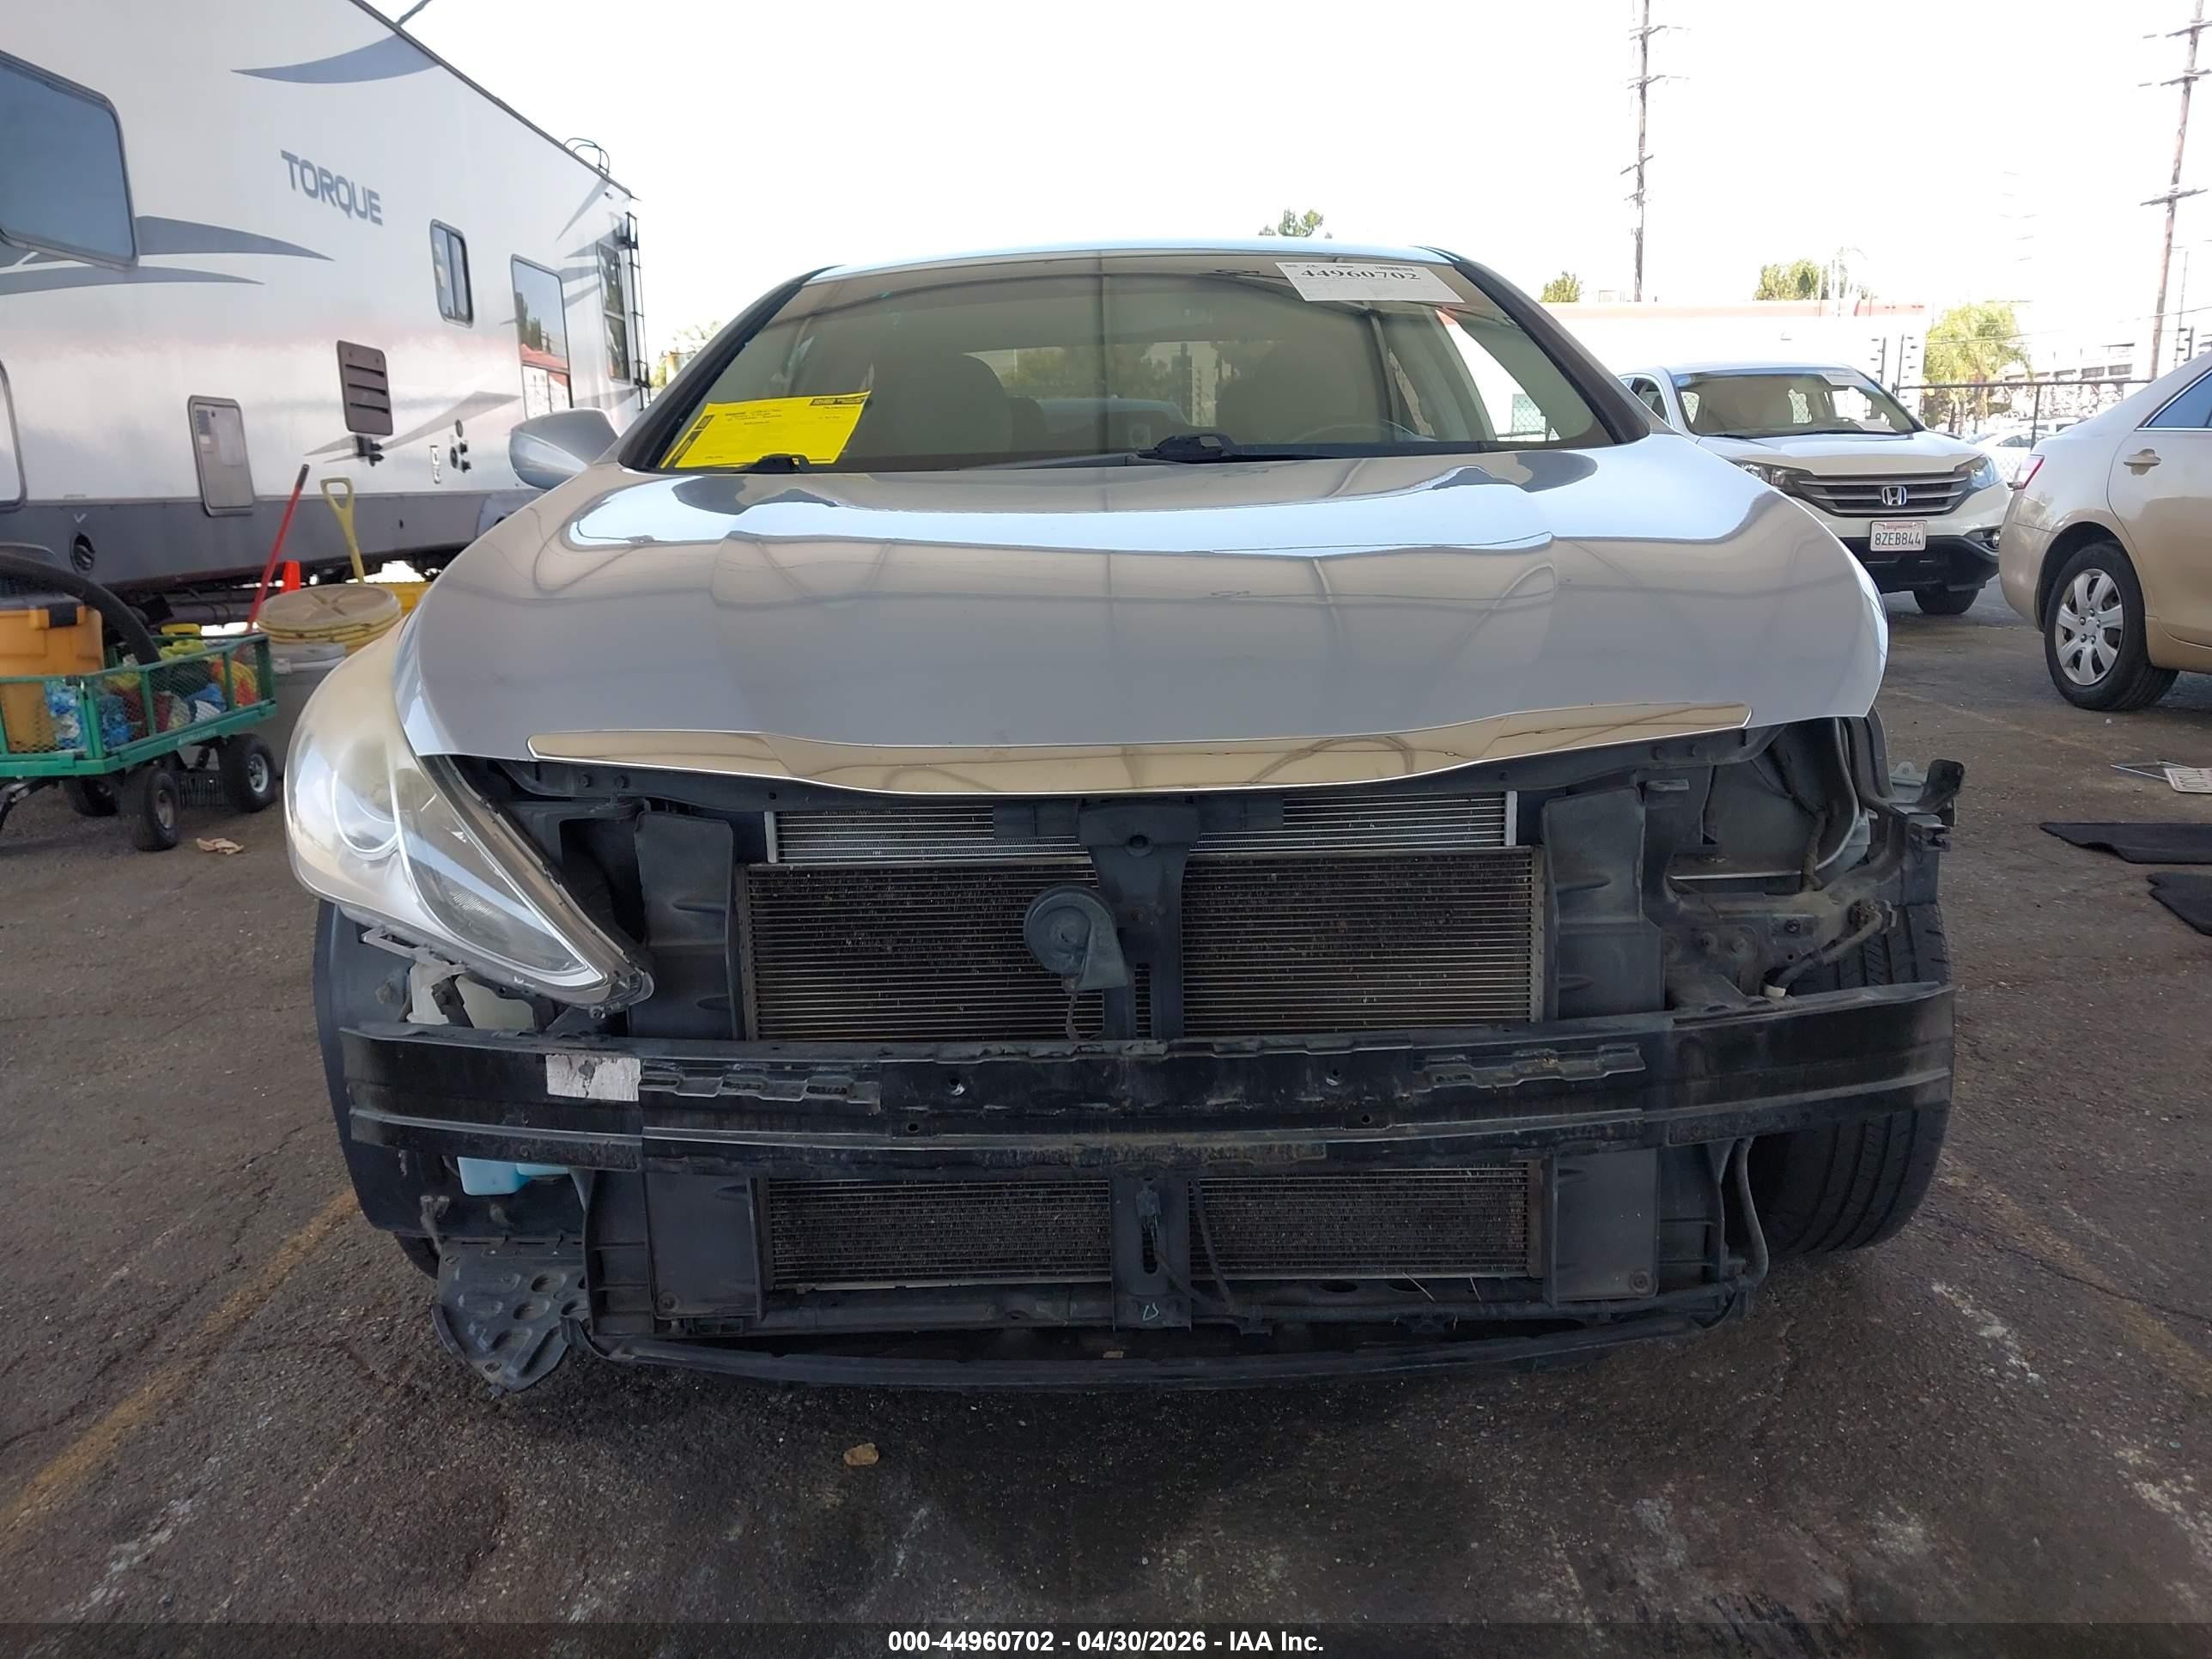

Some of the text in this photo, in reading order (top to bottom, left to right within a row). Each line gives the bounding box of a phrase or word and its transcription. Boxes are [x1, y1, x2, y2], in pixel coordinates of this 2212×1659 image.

[281, 149, 383, 226] TORQUE
[1301, 269, 1421, 280] 44960702
[1875, 532, 1921, 546] 8ZEB844
